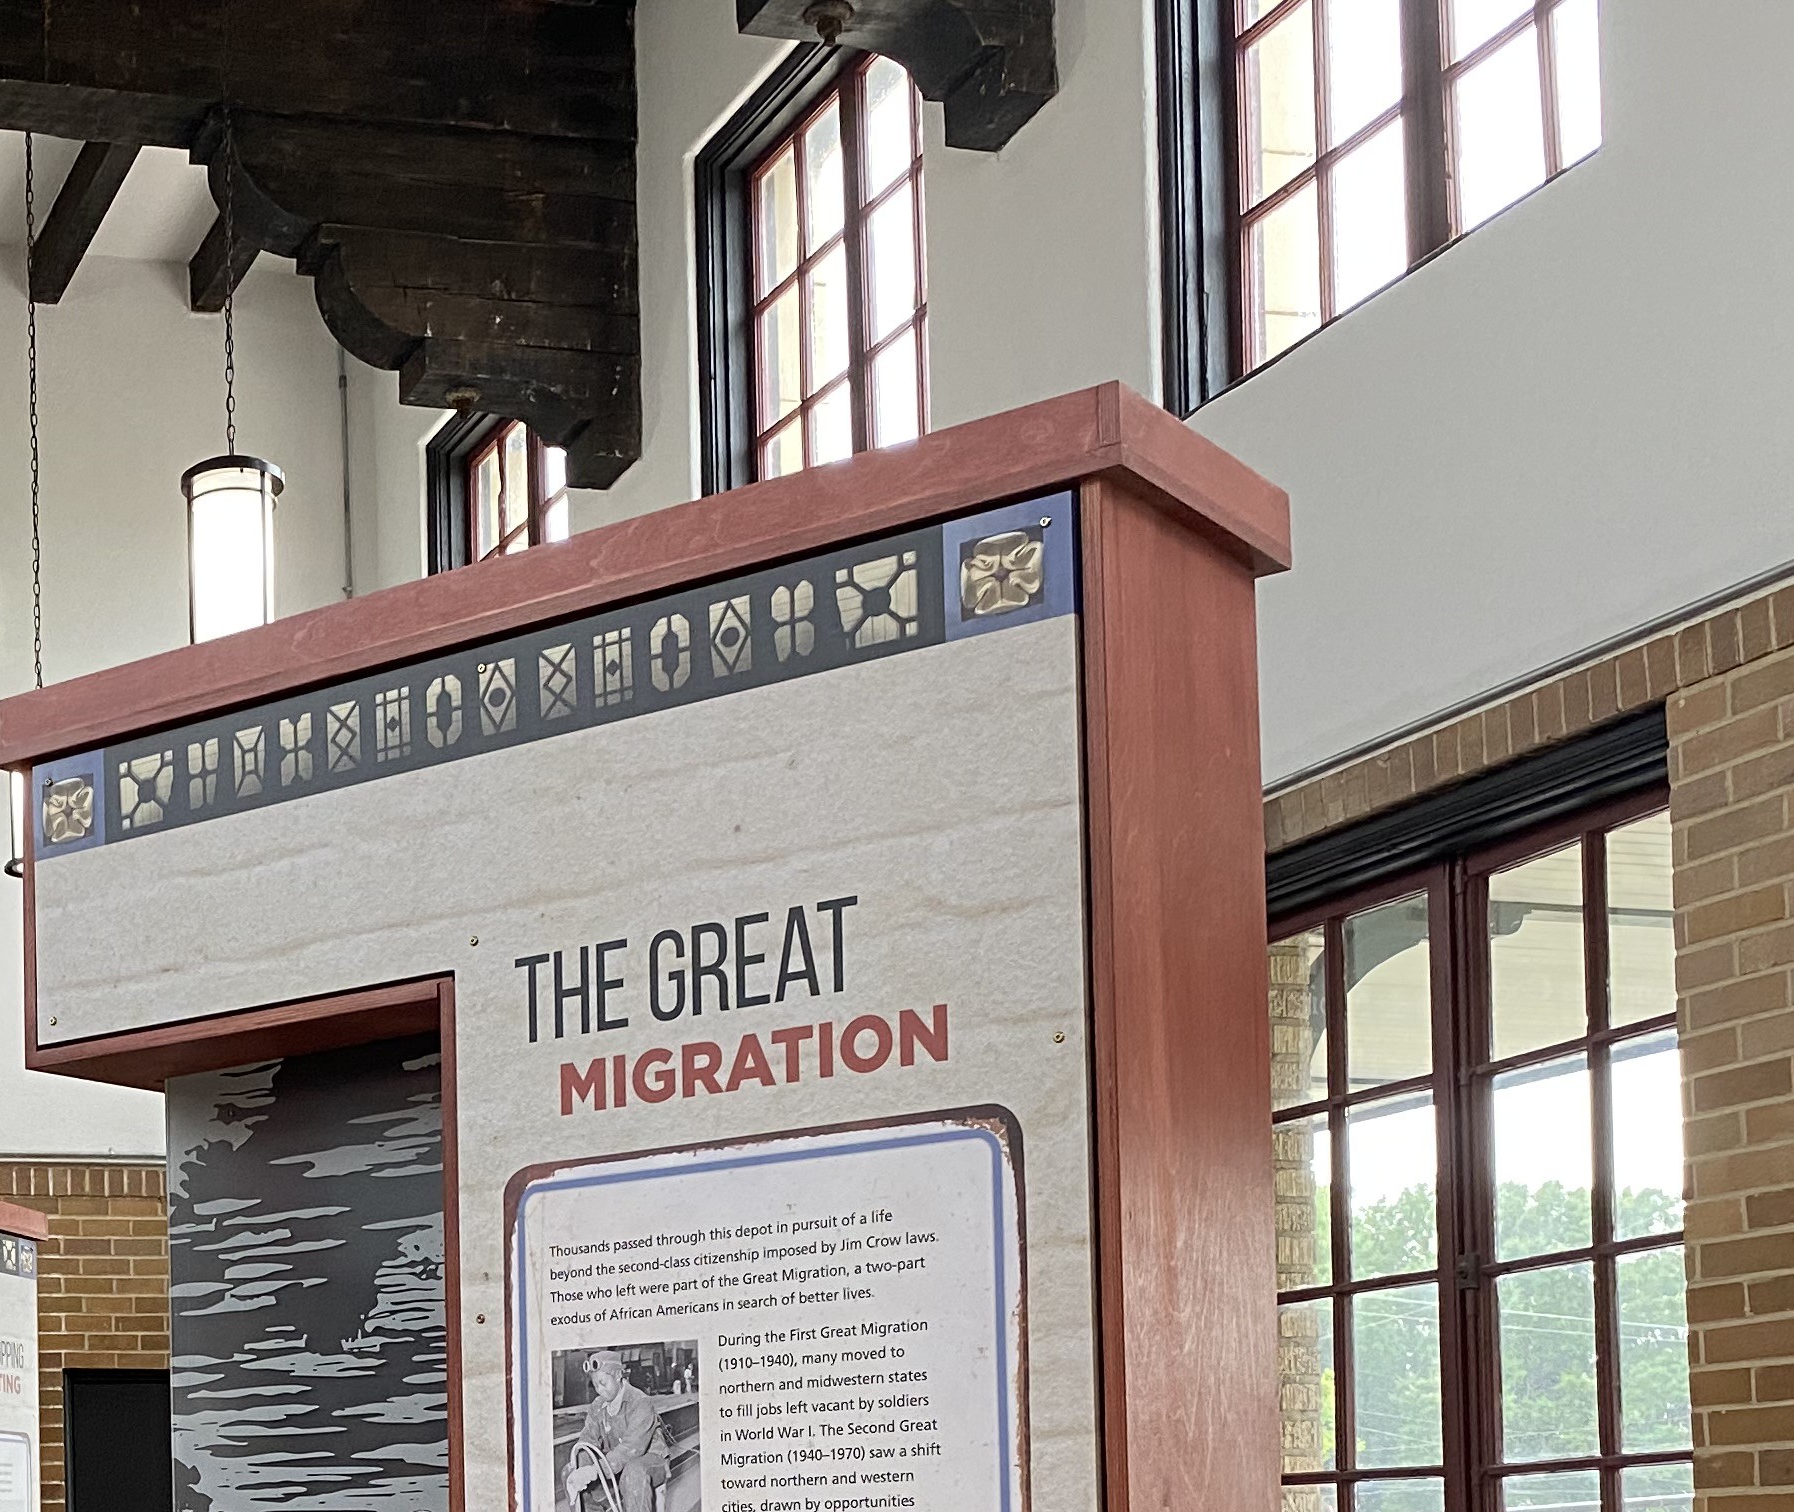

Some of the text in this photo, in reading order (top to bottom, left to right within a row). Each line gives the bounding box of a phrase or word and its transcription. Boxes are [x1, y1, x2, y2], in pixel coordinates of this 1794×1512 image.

[514, 895, 858, 1043] THE GREAT
[559, 1003, 949, 1117] MIGRATION
[548, 1208, 893, 1256] Thousands passed through this depot in pursuit of a life
[549, 1231, 939, 1281] beyond the second-class citizenship imposed by Jim Crow laws.
[549, 1257, 926, 1302] Those who left were part of the Great Migration, a two-part
[550, 1287, 875, 1325] exodus of African Americans in search of better lives.
